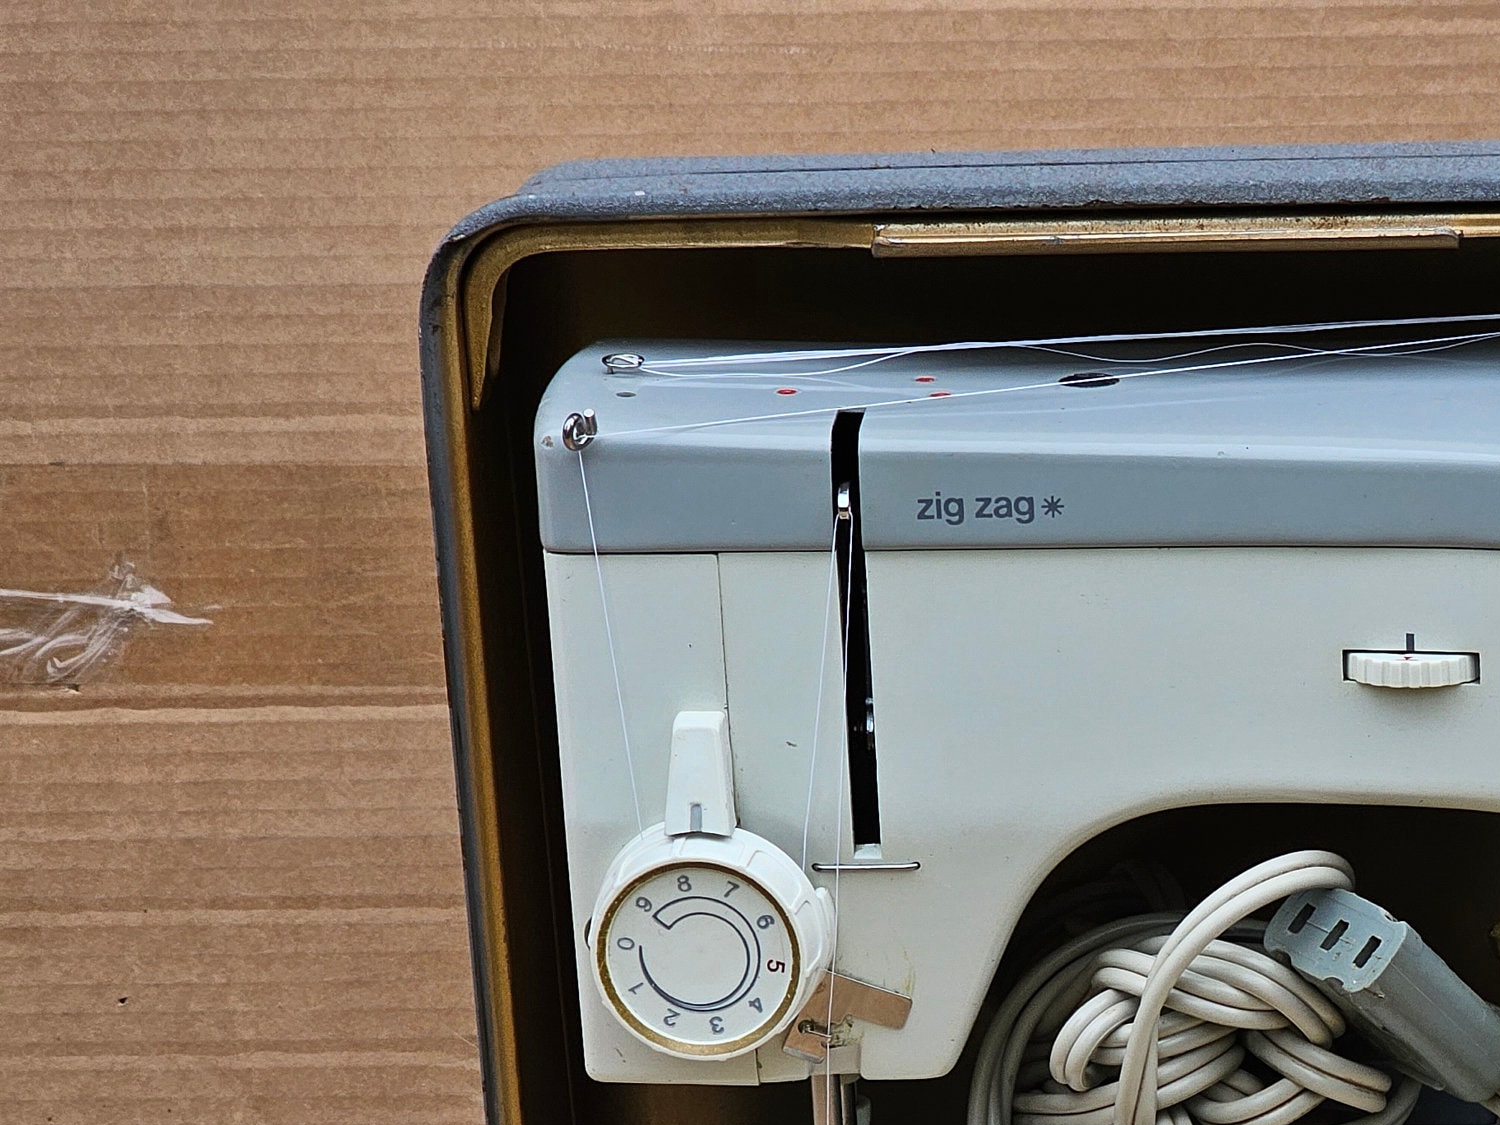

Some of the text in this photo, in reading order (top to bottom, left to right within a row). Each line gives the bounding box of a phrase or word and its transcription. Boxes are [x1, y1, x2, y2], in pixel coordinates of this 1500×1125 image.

[916, 489, 965, 526] zig
[616, 873, 786, 1035] 9 8 7 6 5 4 3 2 1 0
